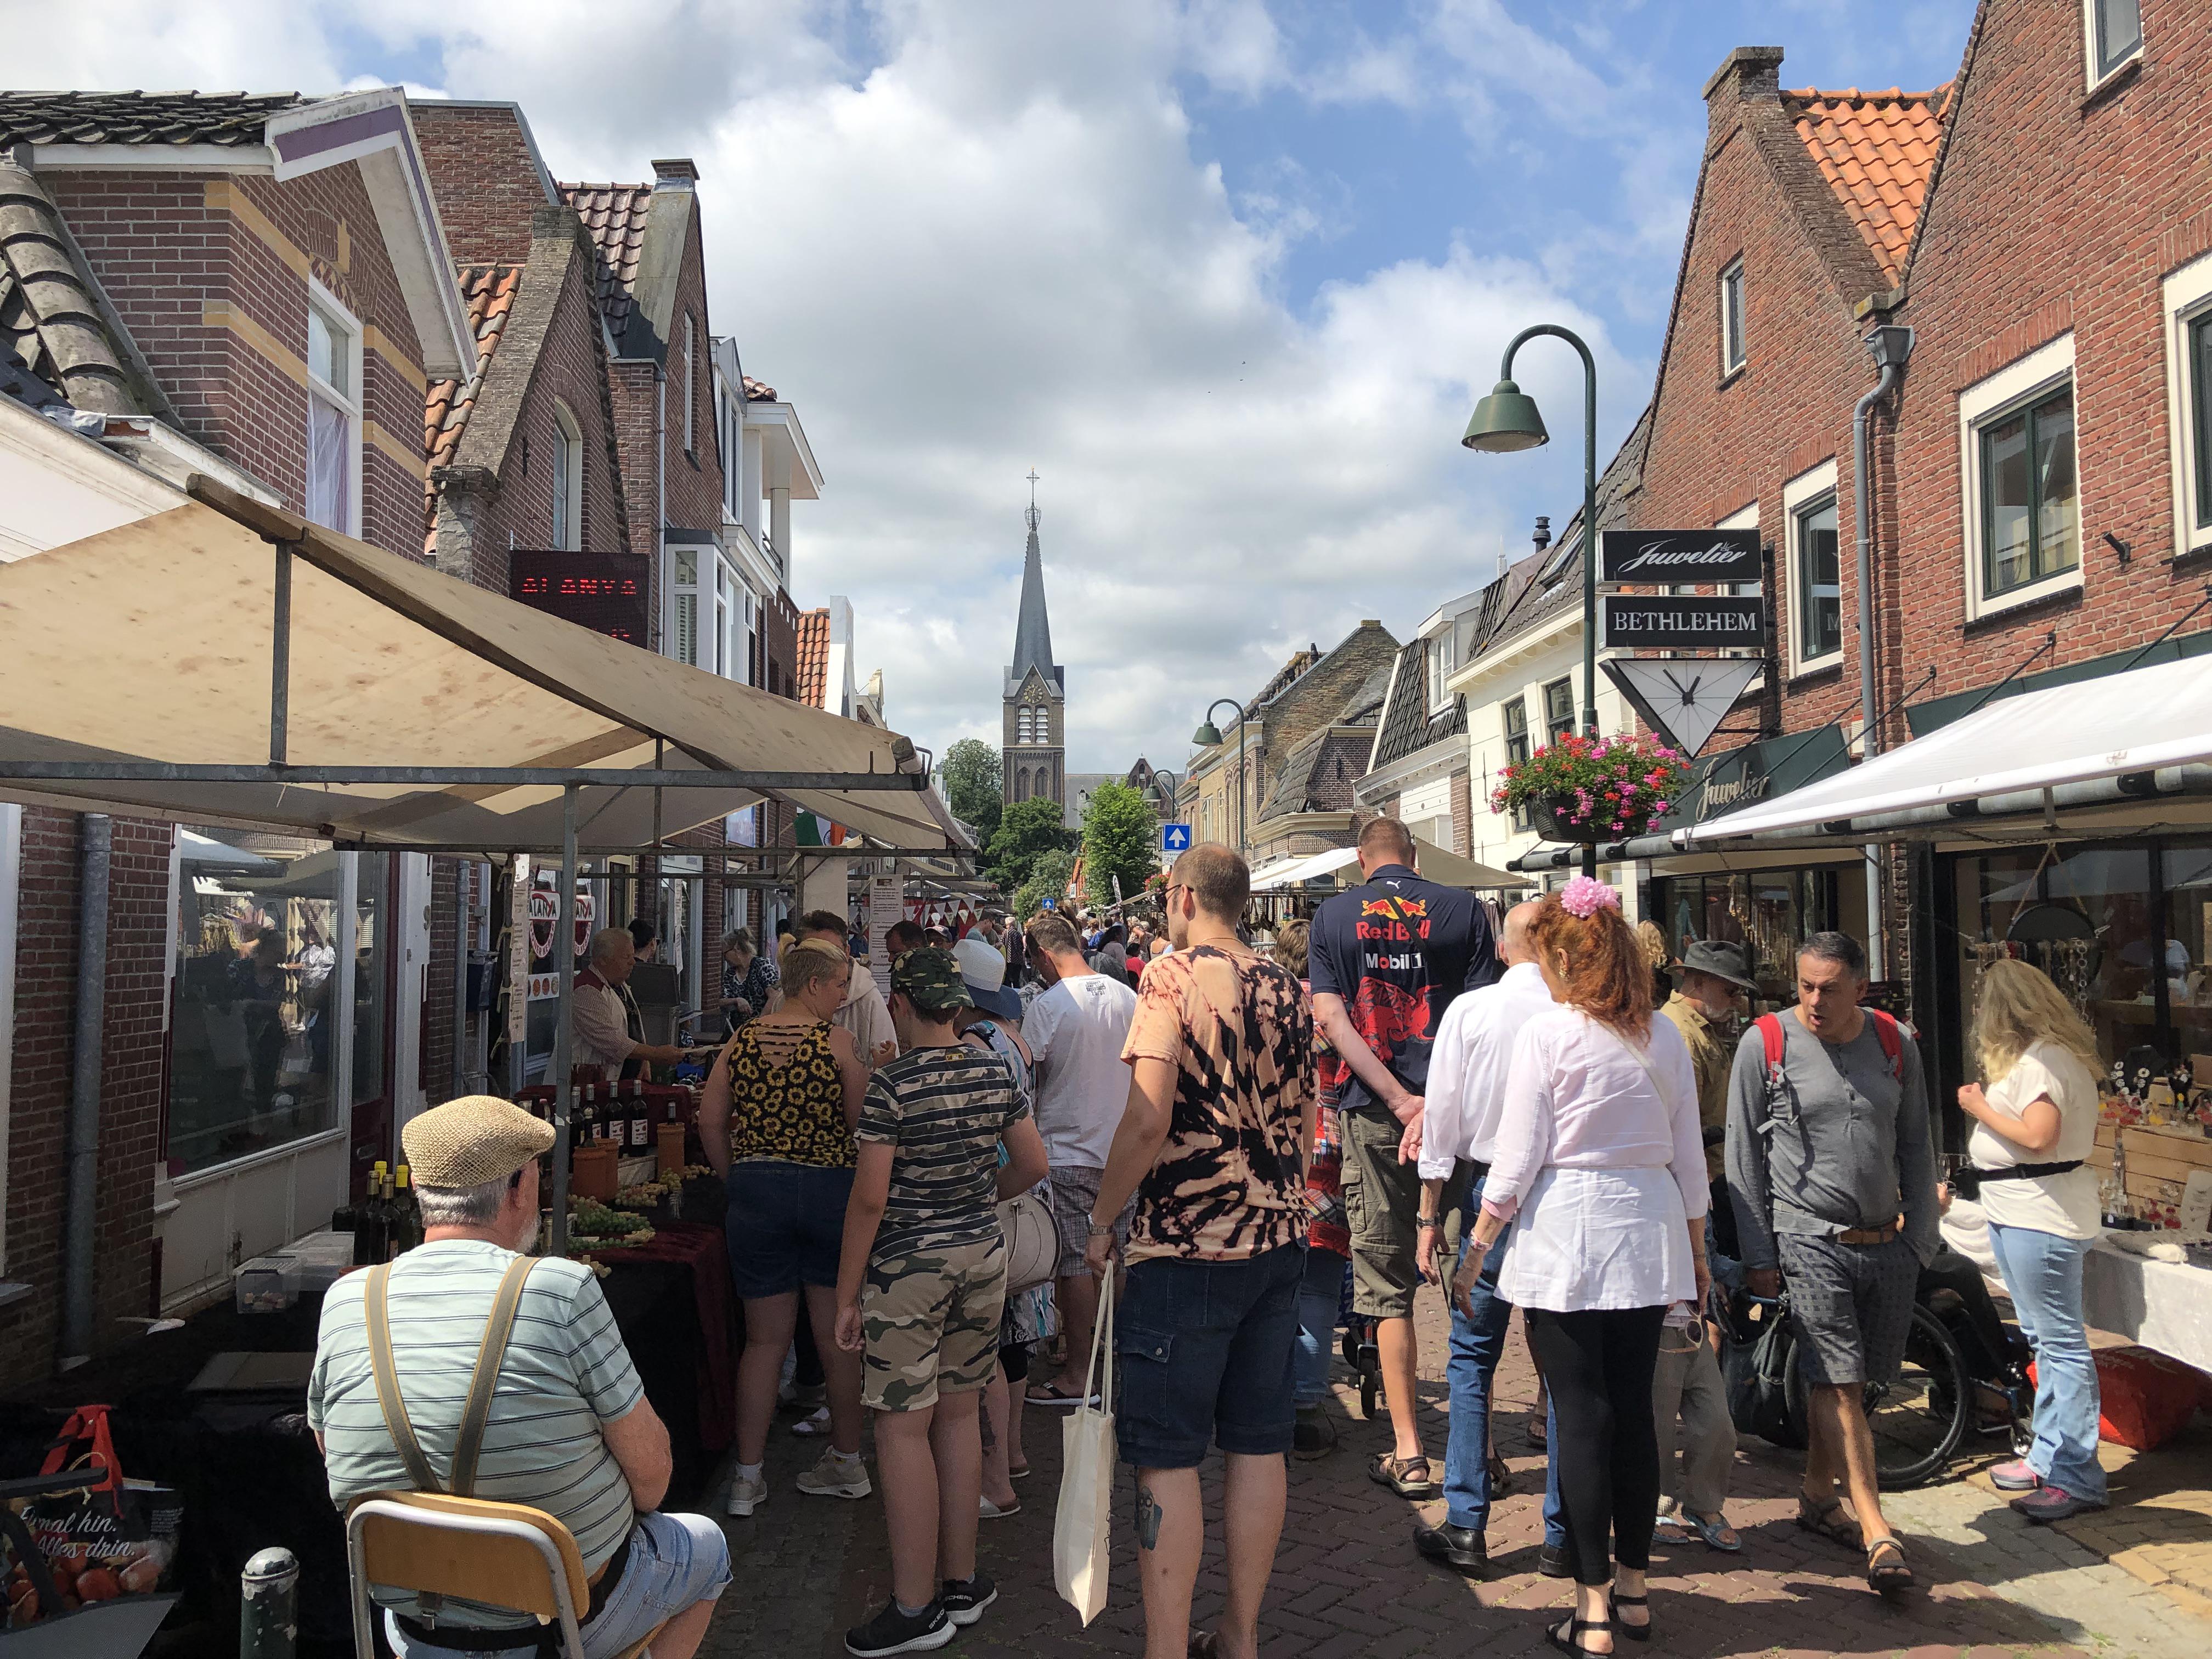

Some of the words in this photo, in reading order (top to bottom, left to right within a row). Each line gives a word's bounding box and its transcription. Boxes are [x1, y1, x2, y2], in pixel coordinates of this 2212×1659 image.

[1618, 538, 1747, 573] Juwelier
[1613, 612, 1757, 631] BETHLEHEM
[1696, 757, 1770, 822] Juwelier
[576, 899, 592, 919] ANYA
[1356, 921, 1393, 940] Red
[1396, 919, 1431, 941] Bll
[1365, 953, 1409, 969] Mobil
[77, 1509, 117, 1533] hin.
[37, 1534, 80, 1559] Alles
[85, 1536, 136, 1559] drin.
